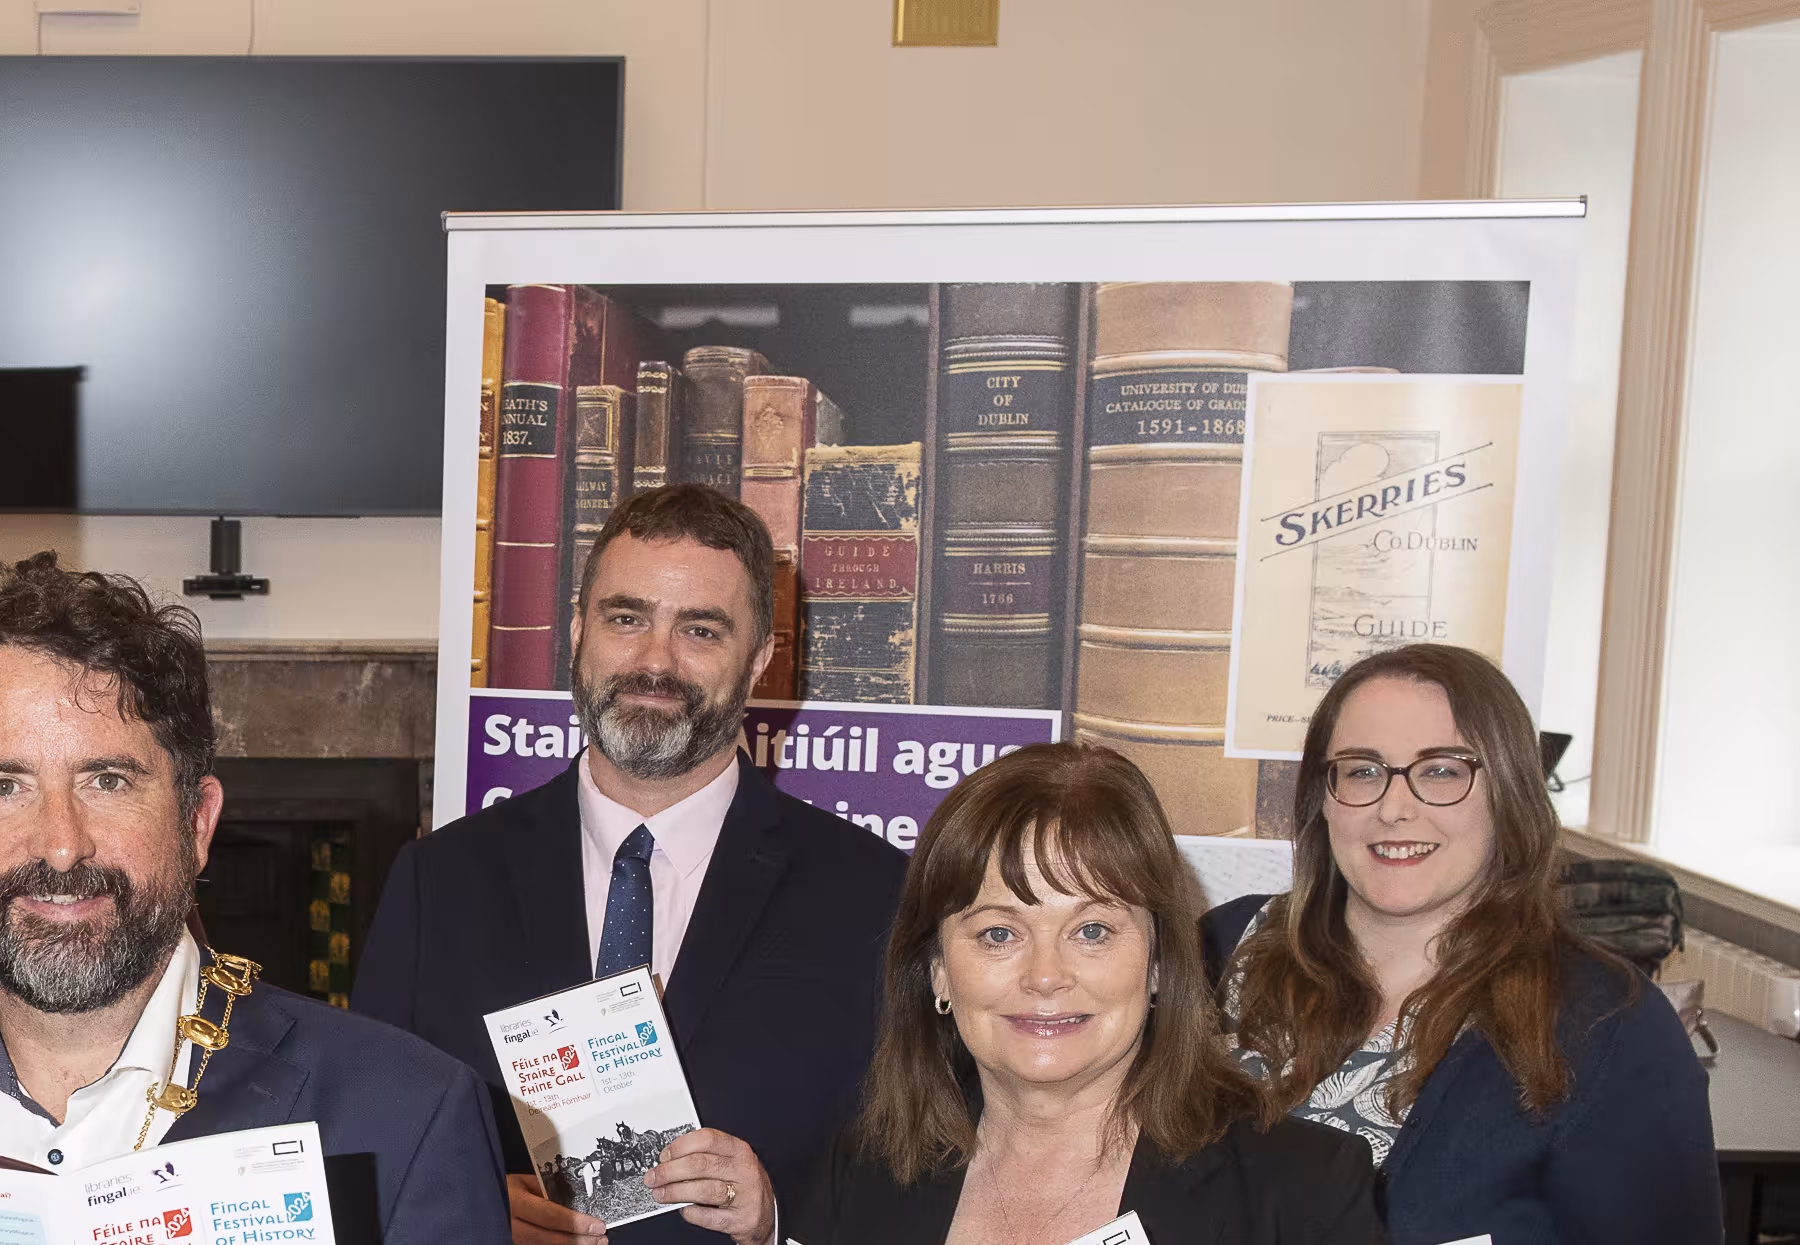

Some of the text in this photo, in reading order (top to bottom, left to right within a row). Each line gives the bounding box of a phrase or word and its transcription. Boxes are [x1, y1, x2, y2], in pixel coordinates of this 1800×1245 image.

[986, 376, 1020, 390] CITY
[1121, 383, 1198, 395] UNIVERSITY
[1202, 383, 1219, 393] OF
[504, 399, 548, 411] EATH'S
[993, 395, 1013, 407] OF
[1106, 401, 1181, 413] CATALOGUE
[1187, 400, 1204, 411] OF
[978, 413, 1029, 426] DUBLIN
[502, 431, 532, 445] 1837.
[1275, 463, 1467, 546] SKERRIES
[825, 545, 891, 558] GUIDE
[832, 563, 880, 574] THROUGH
[973, 563, 1026, 575] HARRIS
[982, 592, 1014, 605] 1766
[1353, 614, 1448, 639] GUIDE
[504, 1027, 539, 1044] fingal.ie
[588, 1031, 628, 1049] FINGAL
[591, 1042, 640, 1061] FESTIVAL
[596, 1047, 663, 1074] OF HISTORY
[518, 1066, 556, 1083] STAIRE
[520, 1071, 586, 1096] FHINE GALL
[604, 1079, 633, 1093] October
[528, 1091, 592, 1116] Deireadh Fómhair
[84, 1174, 135, 1194] libraries.
[87, 1186, 142, 1207] fingal.ie
[210, 1192, 310, 1221] FINGAL 2024
[93, 1208, 190, 1241] FÉILE NA 2024
[213, 1214, 284, 1231] FESTIVAL
[243, 1228, 317, 1243] HISTORY
